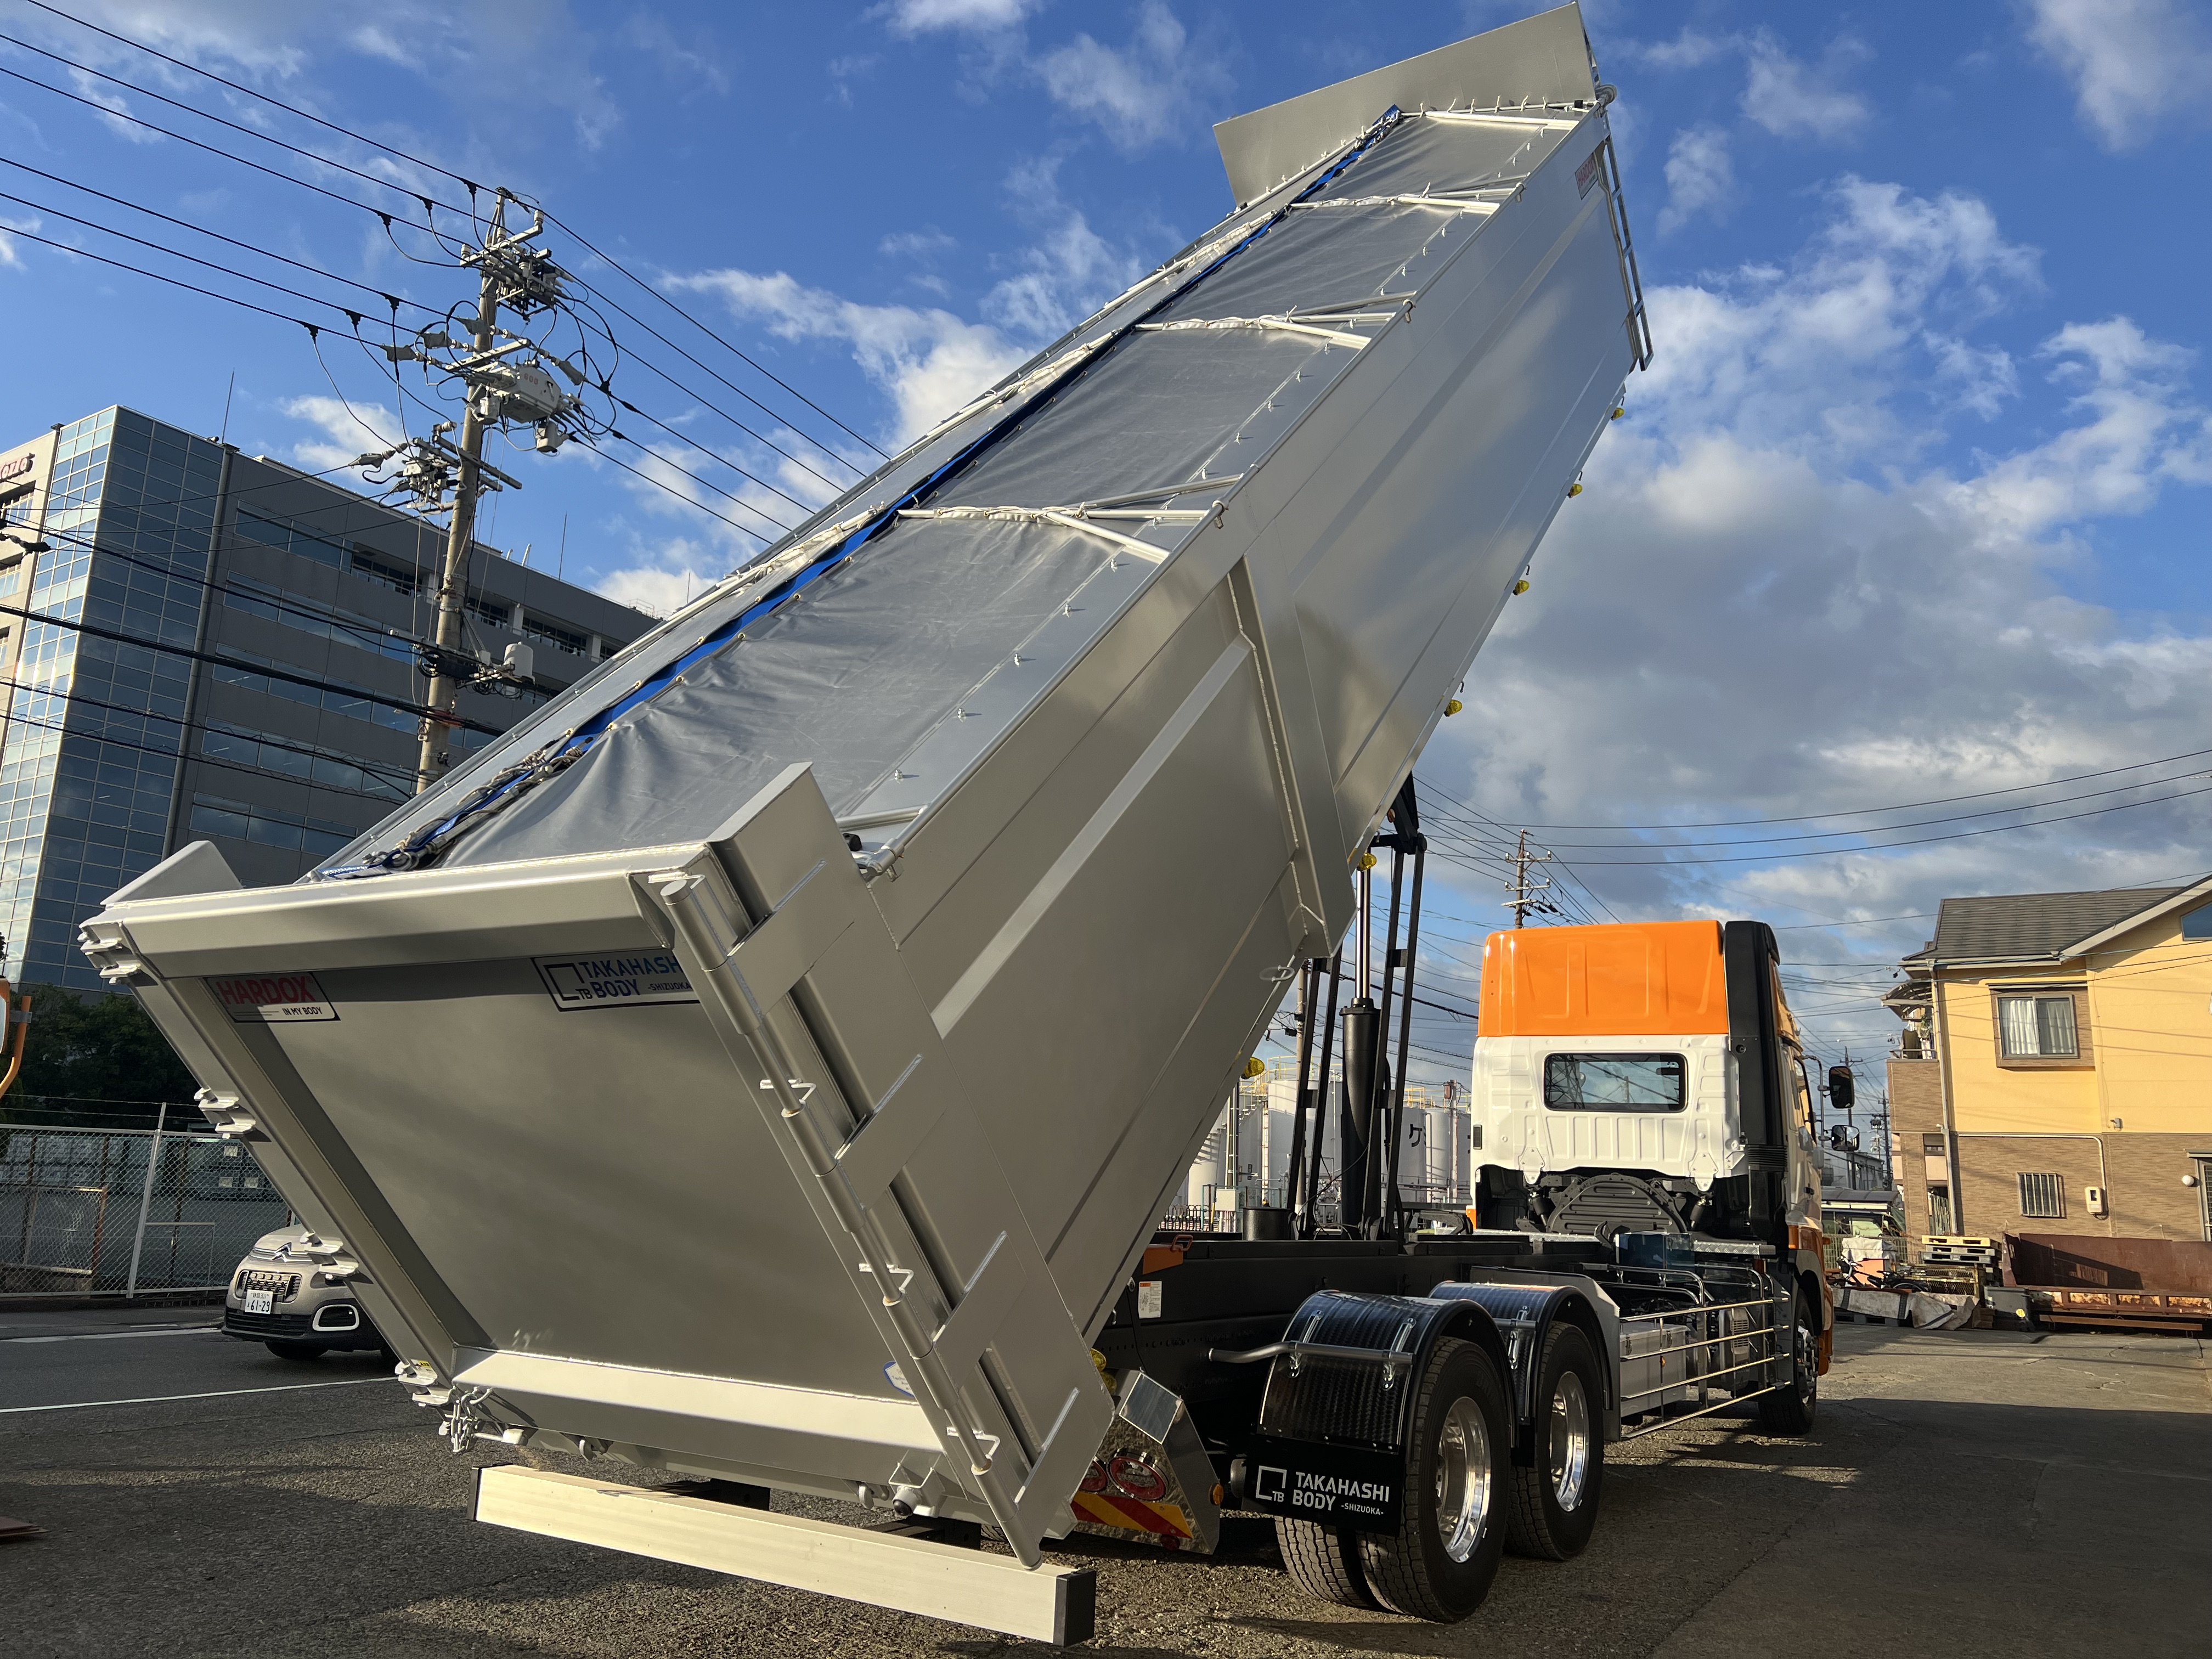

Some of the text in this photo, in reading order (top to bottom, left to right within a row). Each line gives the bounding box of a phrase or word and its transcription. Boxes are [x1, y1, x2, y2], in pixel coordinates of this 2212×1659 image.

[578, 956, 684, 978] TAKAHASH
[575, 989, 593, 1000] TB
[590, 979, 641, 998] BODY
[302, 1007, 323, 1015] BODY
[1295, 1471, 1390, 1502] TAKAHASHI
[1272, 1491, 1284, 1502] TB
[1293, 1489, 1336, 1511] BODY
